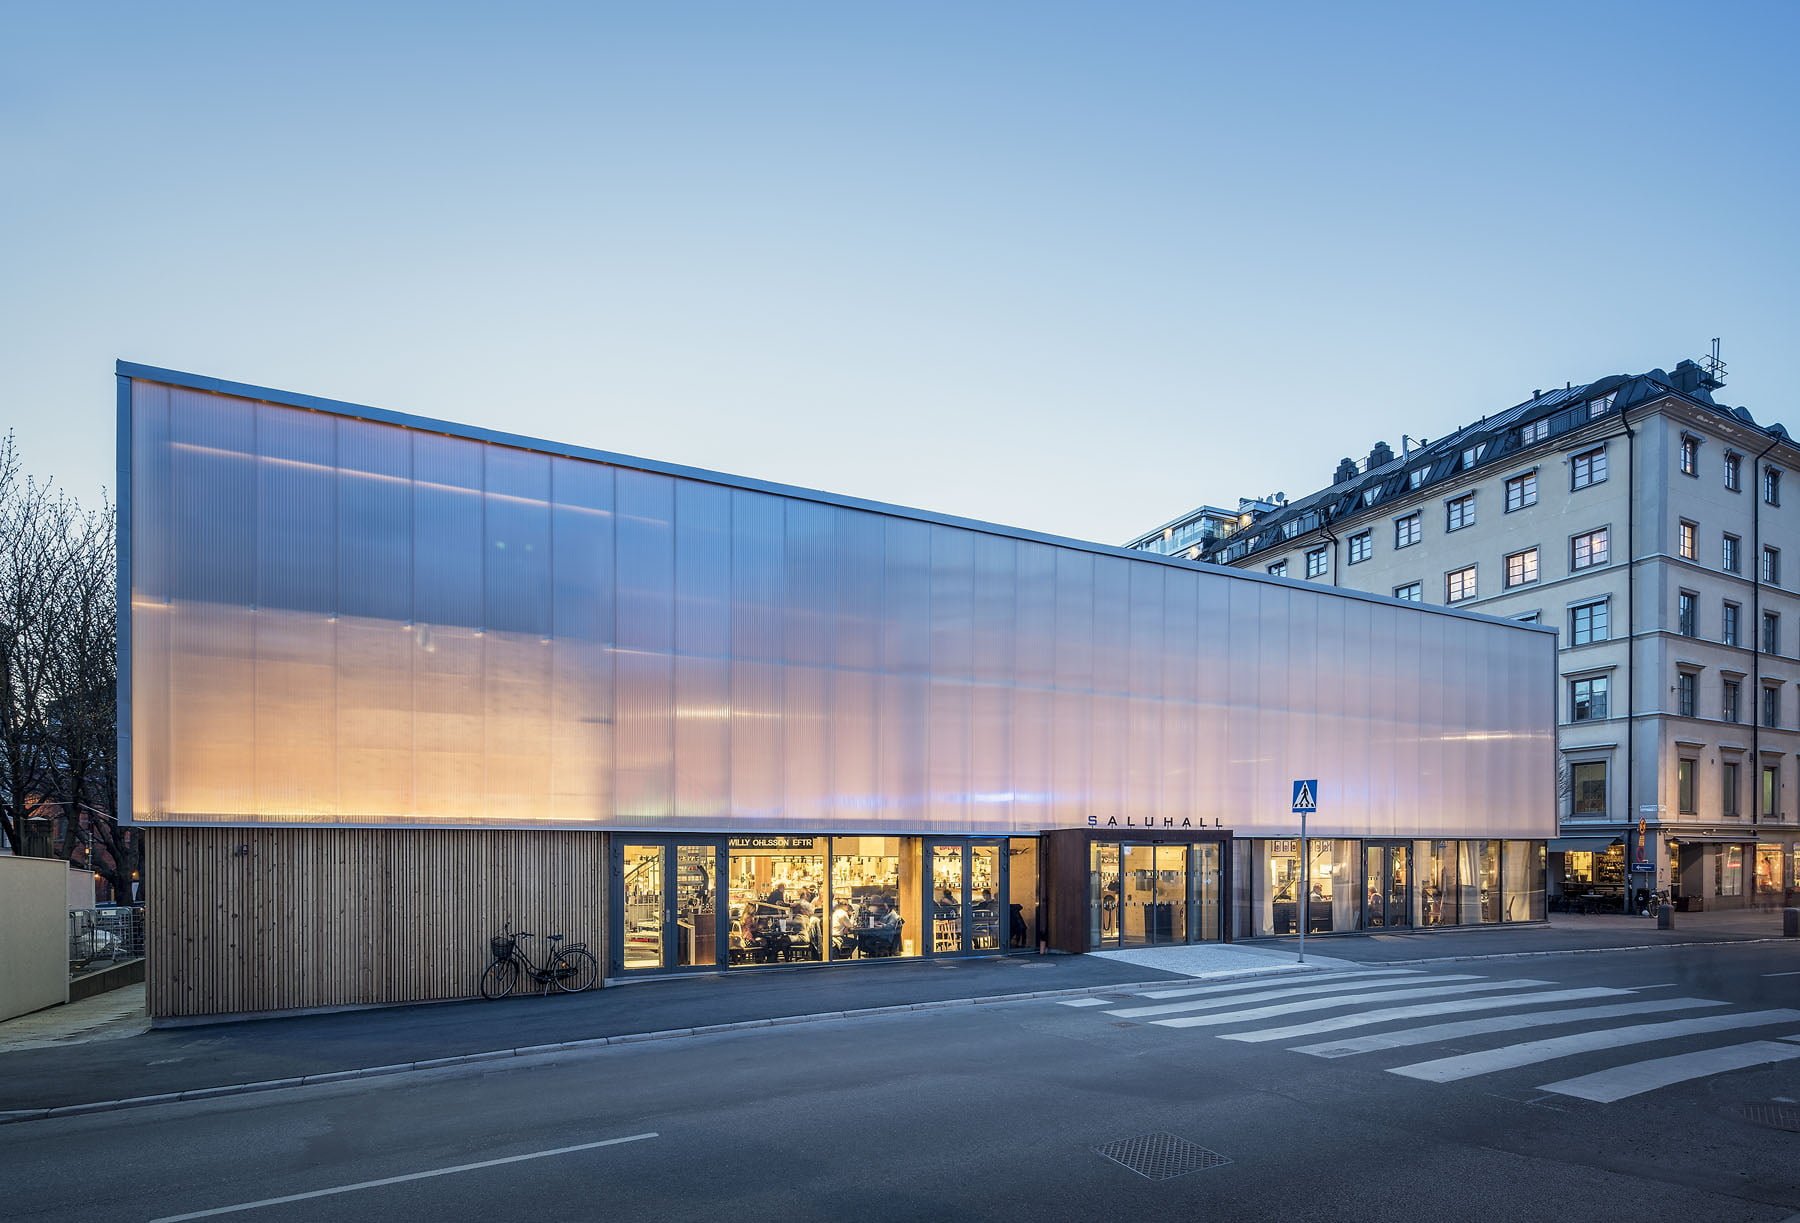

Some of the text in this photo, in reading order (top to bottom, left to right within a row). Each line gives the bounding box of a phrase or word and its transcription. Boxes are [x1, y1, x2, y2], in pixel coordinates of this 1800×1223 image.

[1088, 815, 1223, 827] SALUHALL
[728, 838, 812, 847] WILLY OHLSSON EFTR
